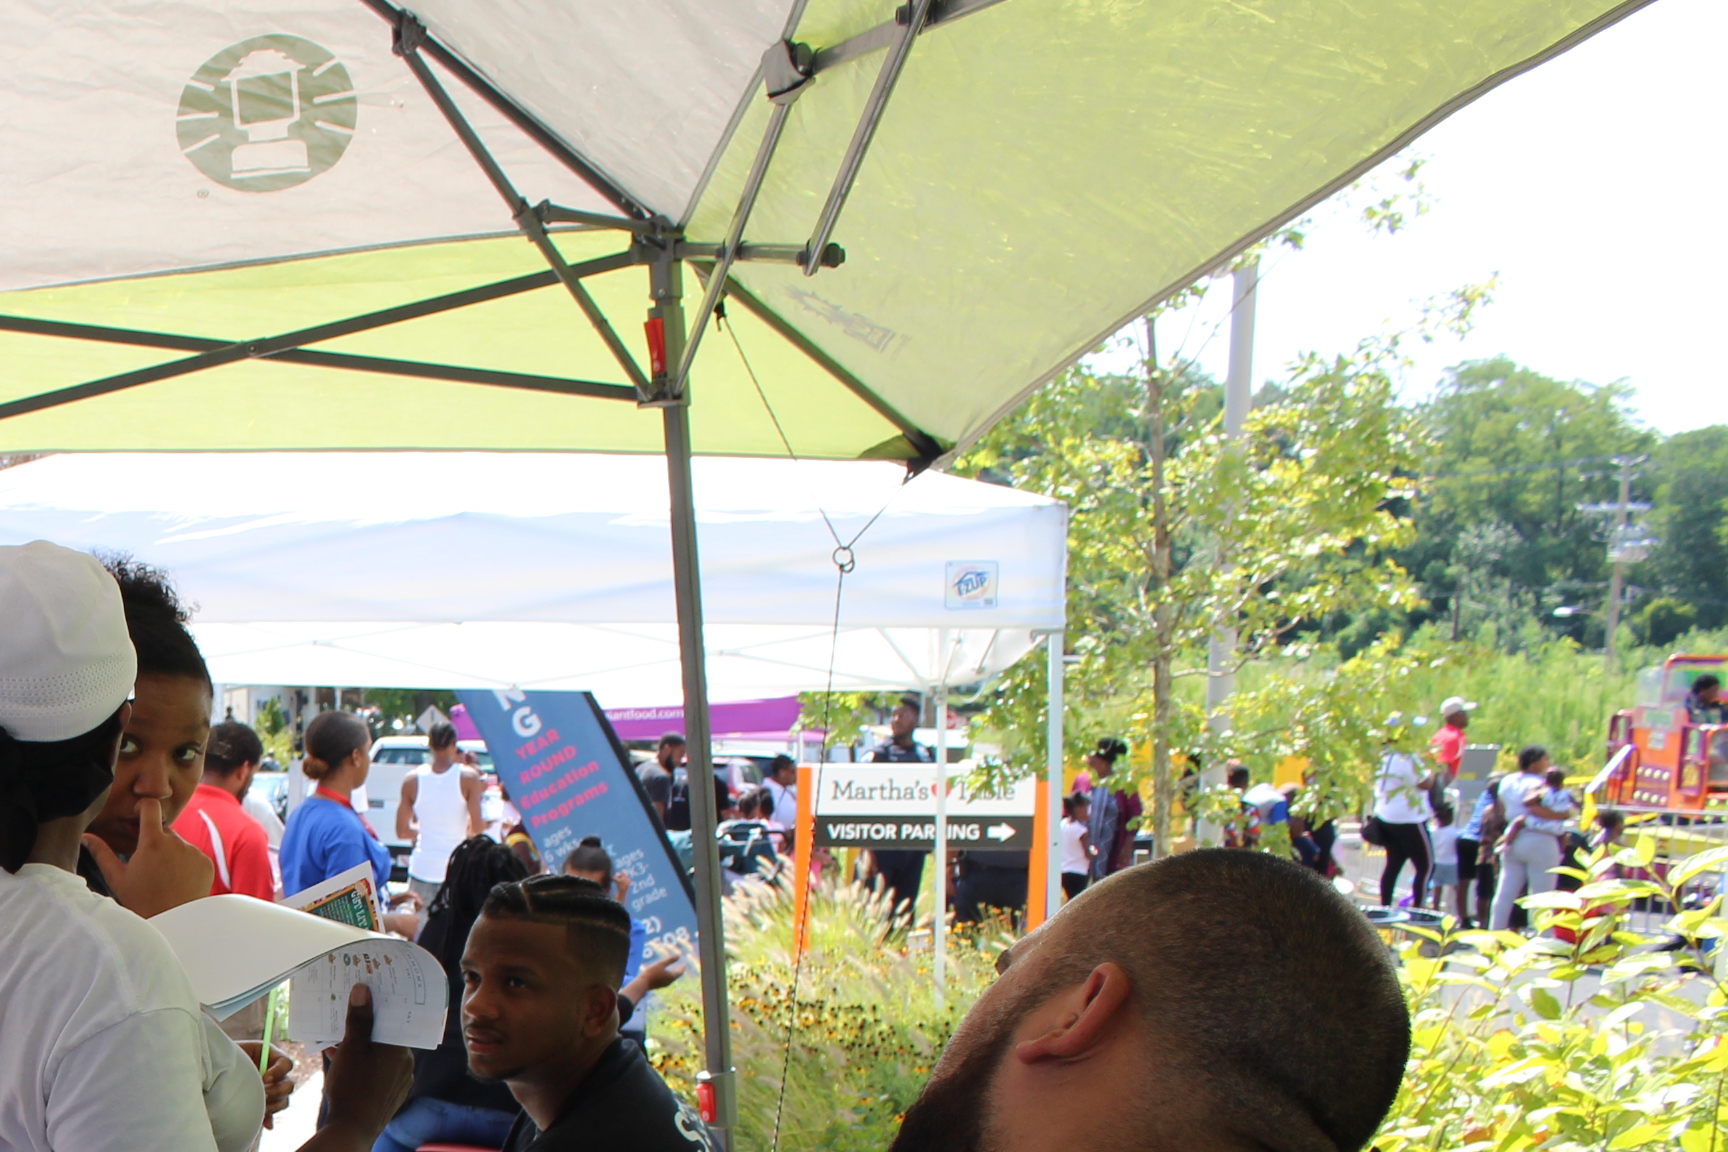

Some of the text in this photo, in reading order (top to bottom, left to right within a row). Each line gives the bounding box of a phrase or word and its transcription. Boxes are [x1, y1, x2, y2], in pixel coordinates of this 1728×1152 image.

[515, 728, 560, 760] YEAR
[519, 745, 577, 785] ROUND
[519, 761, 601, 810] Education
[530, 782, 609, 829] Programs
[543, 825, 572, 848] ages
[828, 823, 980, 840] VISITOR PARING
[615, 849, 646, 869] ages
[630, 873, 655, 895] 2nd
[631, 887, 668, 912] grade
